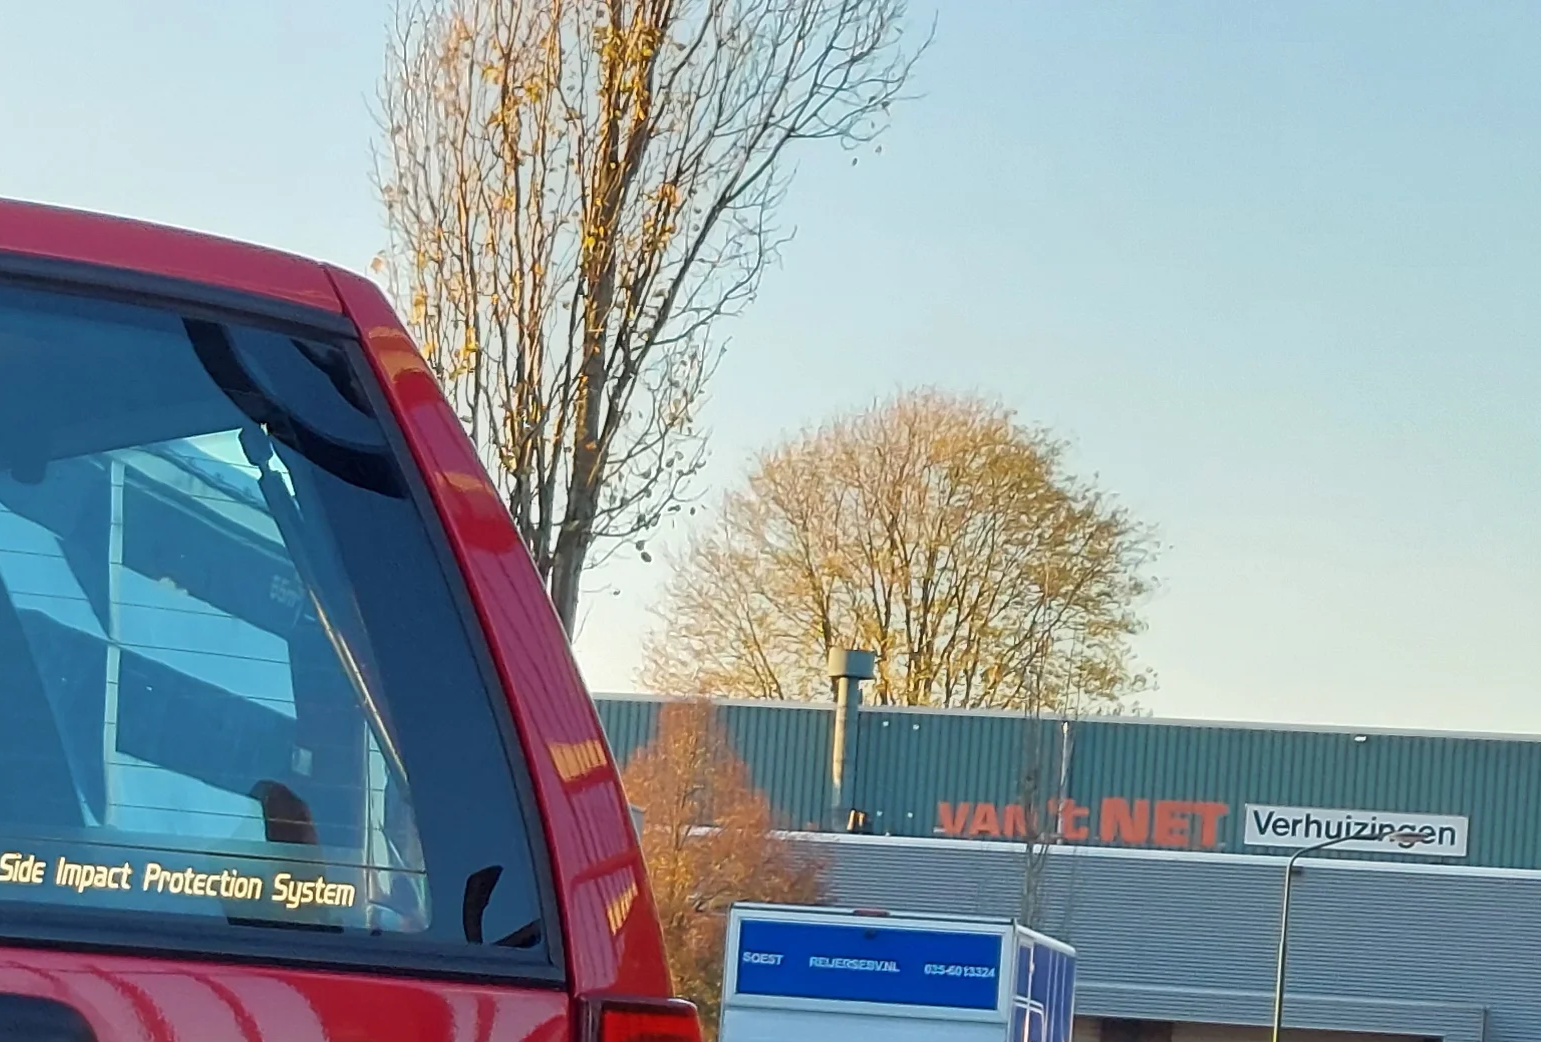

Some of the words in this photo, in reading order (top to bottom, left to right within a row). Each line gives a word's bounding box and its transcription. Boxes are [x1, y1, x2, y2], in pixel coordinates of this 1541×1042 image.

[1100, 796, 1229, 848] NET
[55, 856, 132, 893] Impact
[142, 866, 263, 901] Protection
[271, 878, 357, 909] System
[742, 951, 785, 966] SOEST
